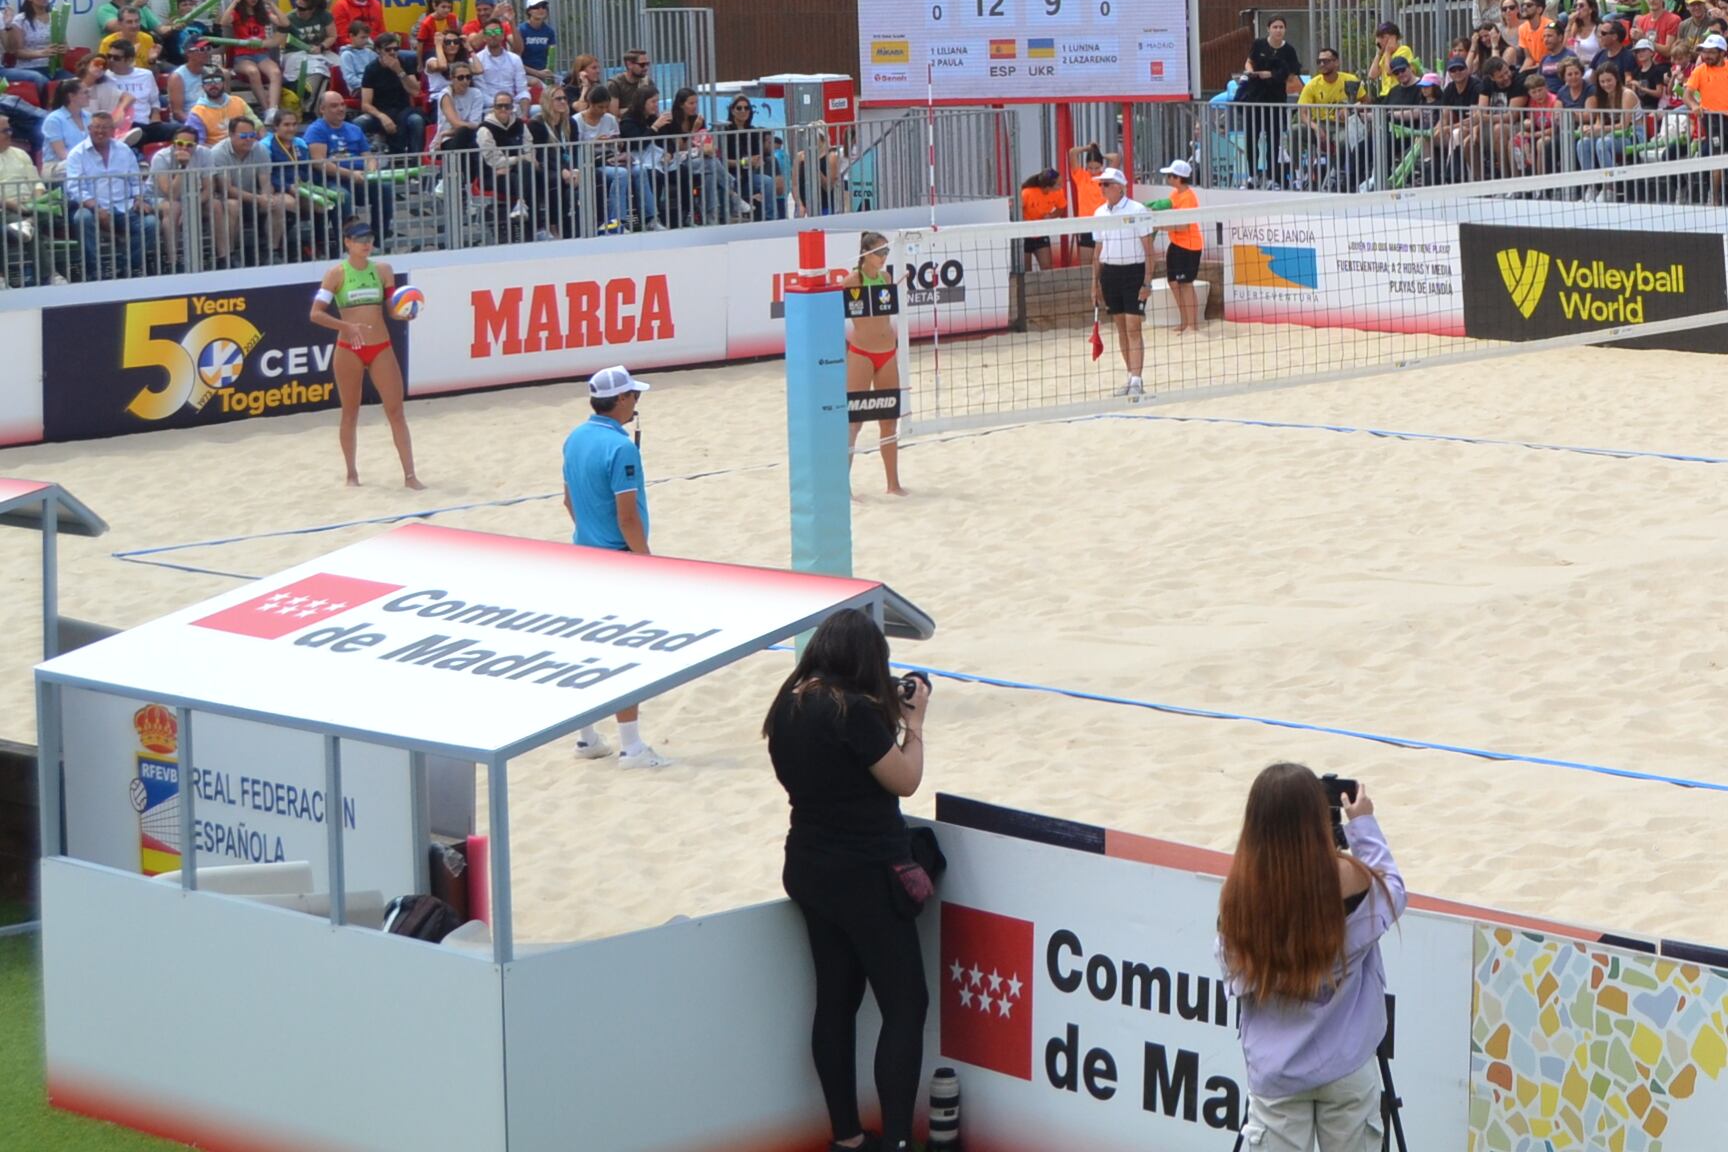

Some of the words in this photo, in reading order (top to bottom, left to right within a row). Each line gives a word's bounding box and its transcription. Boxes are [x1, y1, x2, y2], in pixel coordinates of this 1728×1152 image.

[932, 5, 942, 21] 0
[1100, 1, 1111, 16] 0
[937, 47, 968, 55] LILIANA
[1068, 44, 1100, 52] LUNINA
[937, 59, 964, 67] PAULA
[1062, 56, 1067, 64] 2
[1069, 55, 1118, 64] LAZARENKO
[989, 66, 1016, 77] ESP
[1028, 65, 1055, 76] UKR
[1231, 227, 1265, 242] PLAYAS
[1267, 228, 1280, 242] DE
[1403, 262, 1424, 275] HORAS
[1556, 258, 1685, 294] Volleyball
[1389, 280, 1416, 294] PLAYAS
[1418, 281, 1427, 294] DE
[1233, 290, 1319, 303] FUERTEVENTURA
[192, 296, 247, 315] Years
[1559, 291, 1644, 323] World
[471, 274, 674, 358] MARCA
[260, 344, 334, 378] CEV
[217, 380, 334, 416] Together
[848, 396, 897, 411] MADRID
[382, 588, 722, 653] Comunidad
[293, 622, 386, 653] de
[378, 633, 641, 690] Madrid
[141, 762, 178, 783] RFEVB
[192, 767, 236, 805] REAL
[240, 775, 356, 830] FEDERACIN
[195, 819, 286, 864] ESPAÑOLA
[1045, 1034, 1118, 1101] de
